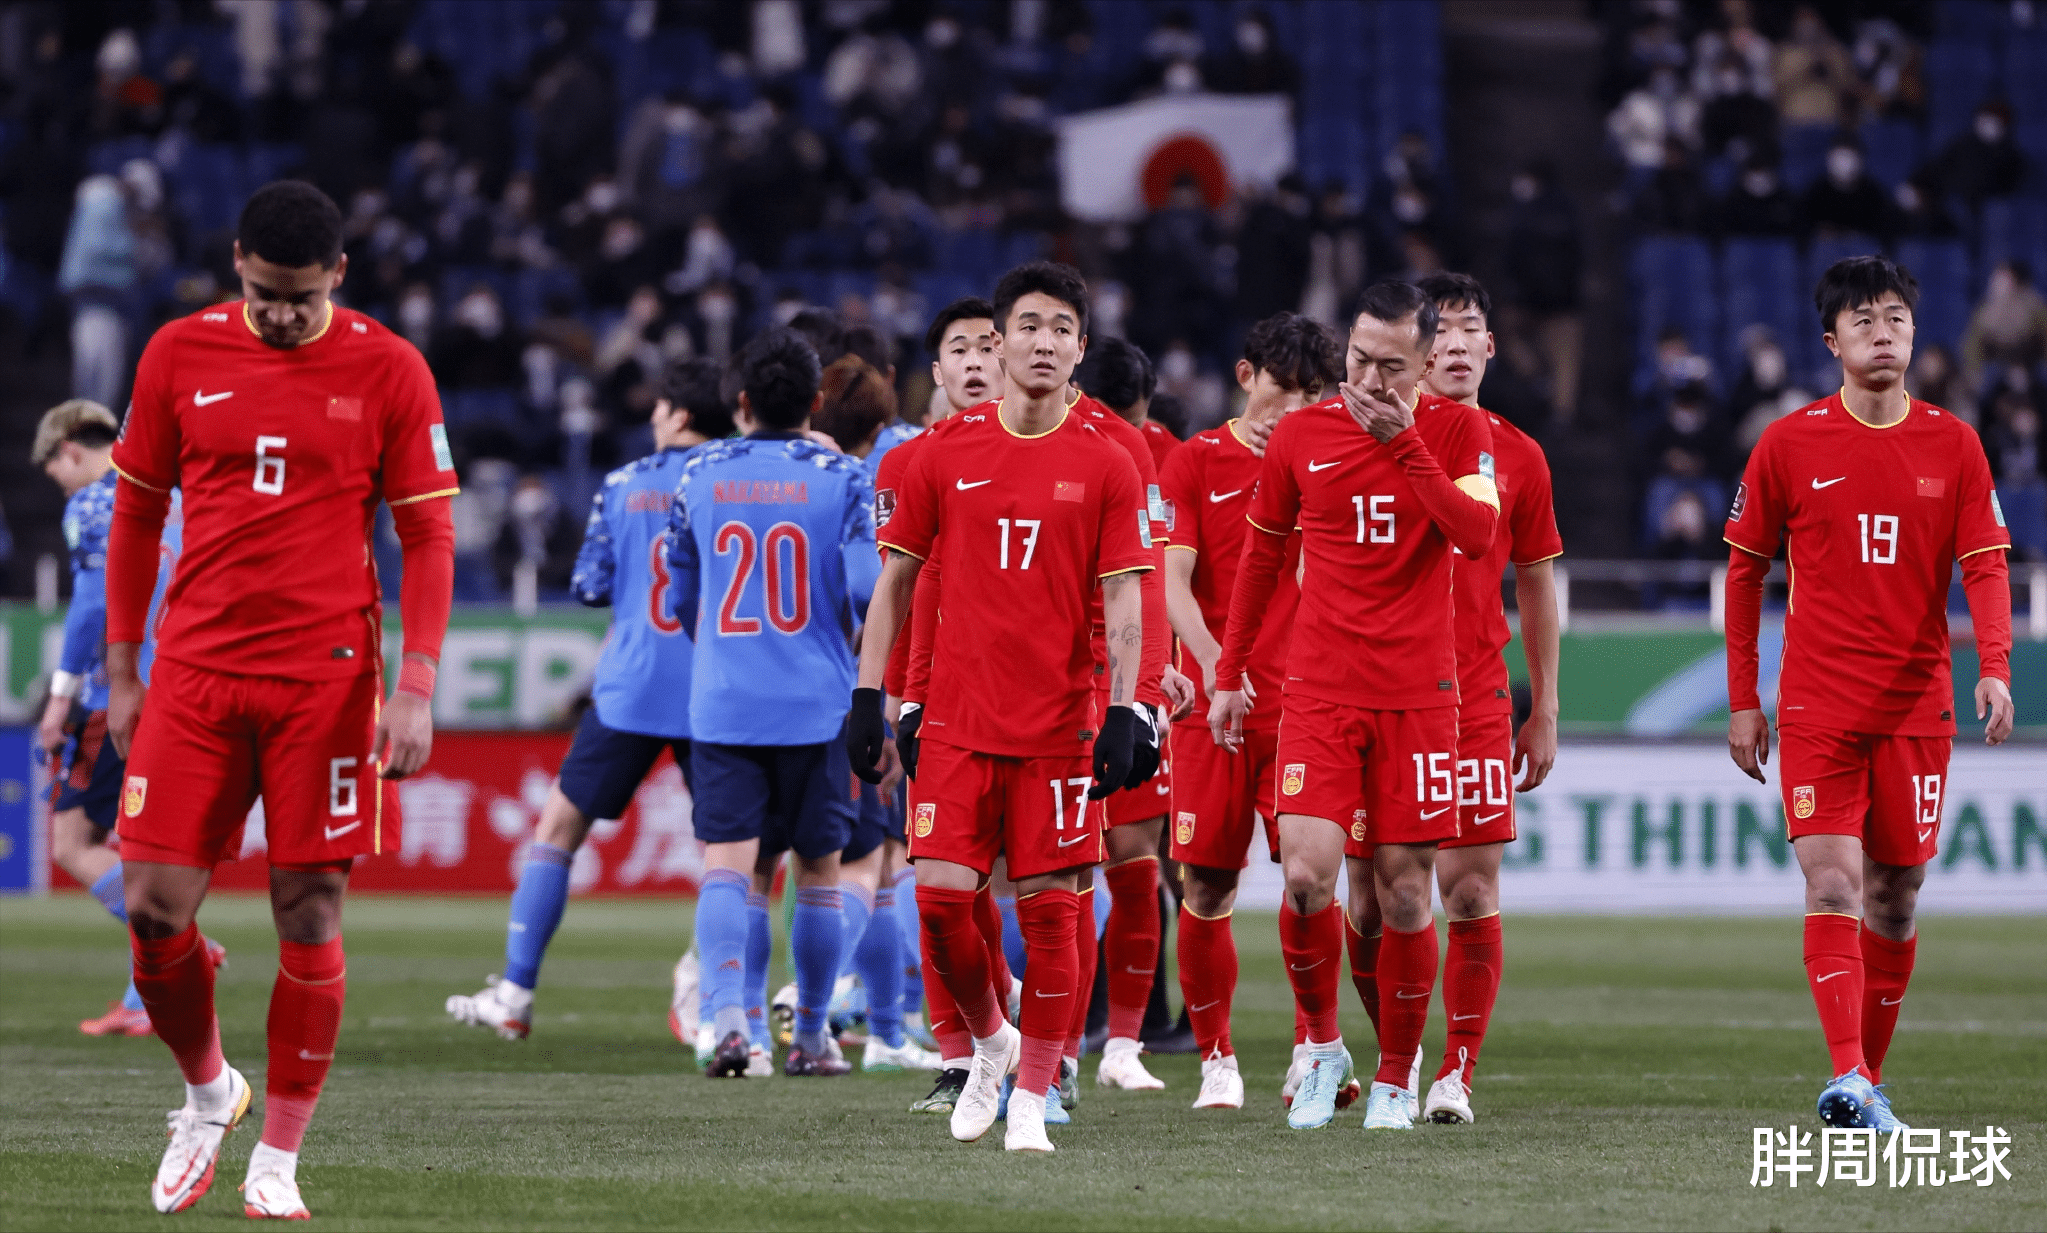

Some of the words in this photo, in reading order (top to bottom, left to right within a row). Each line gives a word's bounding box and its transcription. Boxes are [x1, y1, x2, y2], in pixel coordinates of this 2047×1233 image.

[252, 435, 288, 496] 6
[997, 517, 1042, 570] 17
[1351, 495, 1396, 544] 15
[1857, 513, 1899, 565] 19
[713, 519, 811, 638] 20
[329, 756, 358, 817] 6
[1049, 775, 1093, 831] 17
[1412, 752, 1454, 803] 15
[1457, 758, 1509, 807] 20
[1912, 774, 1942, 825] 19
